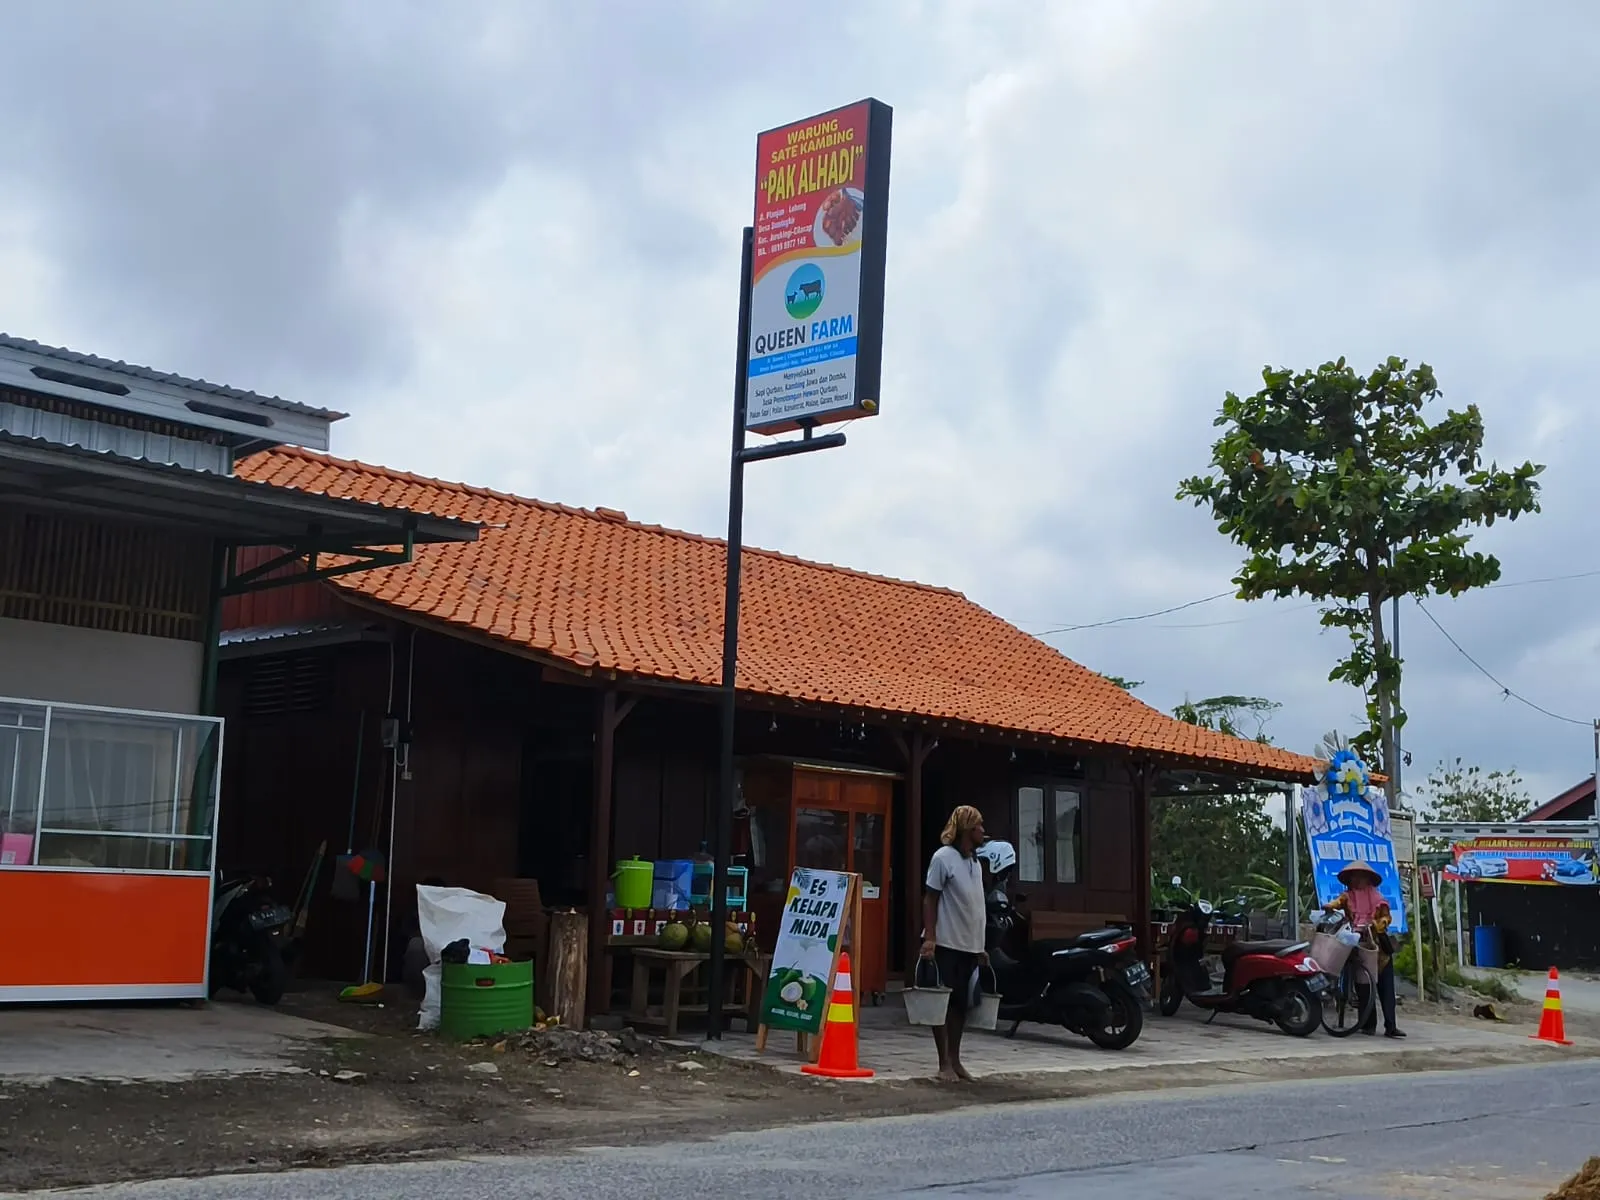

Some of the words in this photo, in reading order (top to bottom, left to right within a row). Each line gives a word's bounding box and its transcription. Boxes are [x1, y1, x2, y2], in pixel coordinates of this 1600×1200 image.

[787, 119, 838, 145] WARUNG
[771, 145, 798, 163] SATE
[800, 128, 854, 155] KAMBING
[755, 325, 806, 354] QUEEN
[811, 314, 853, 342] FARM
[783, 368, 816, 380] Menyediakan
[809, 878, 828, 896] ES
[789, 897, 839, 919] KELAPA
[789, 918, 830, 939] MUDA
